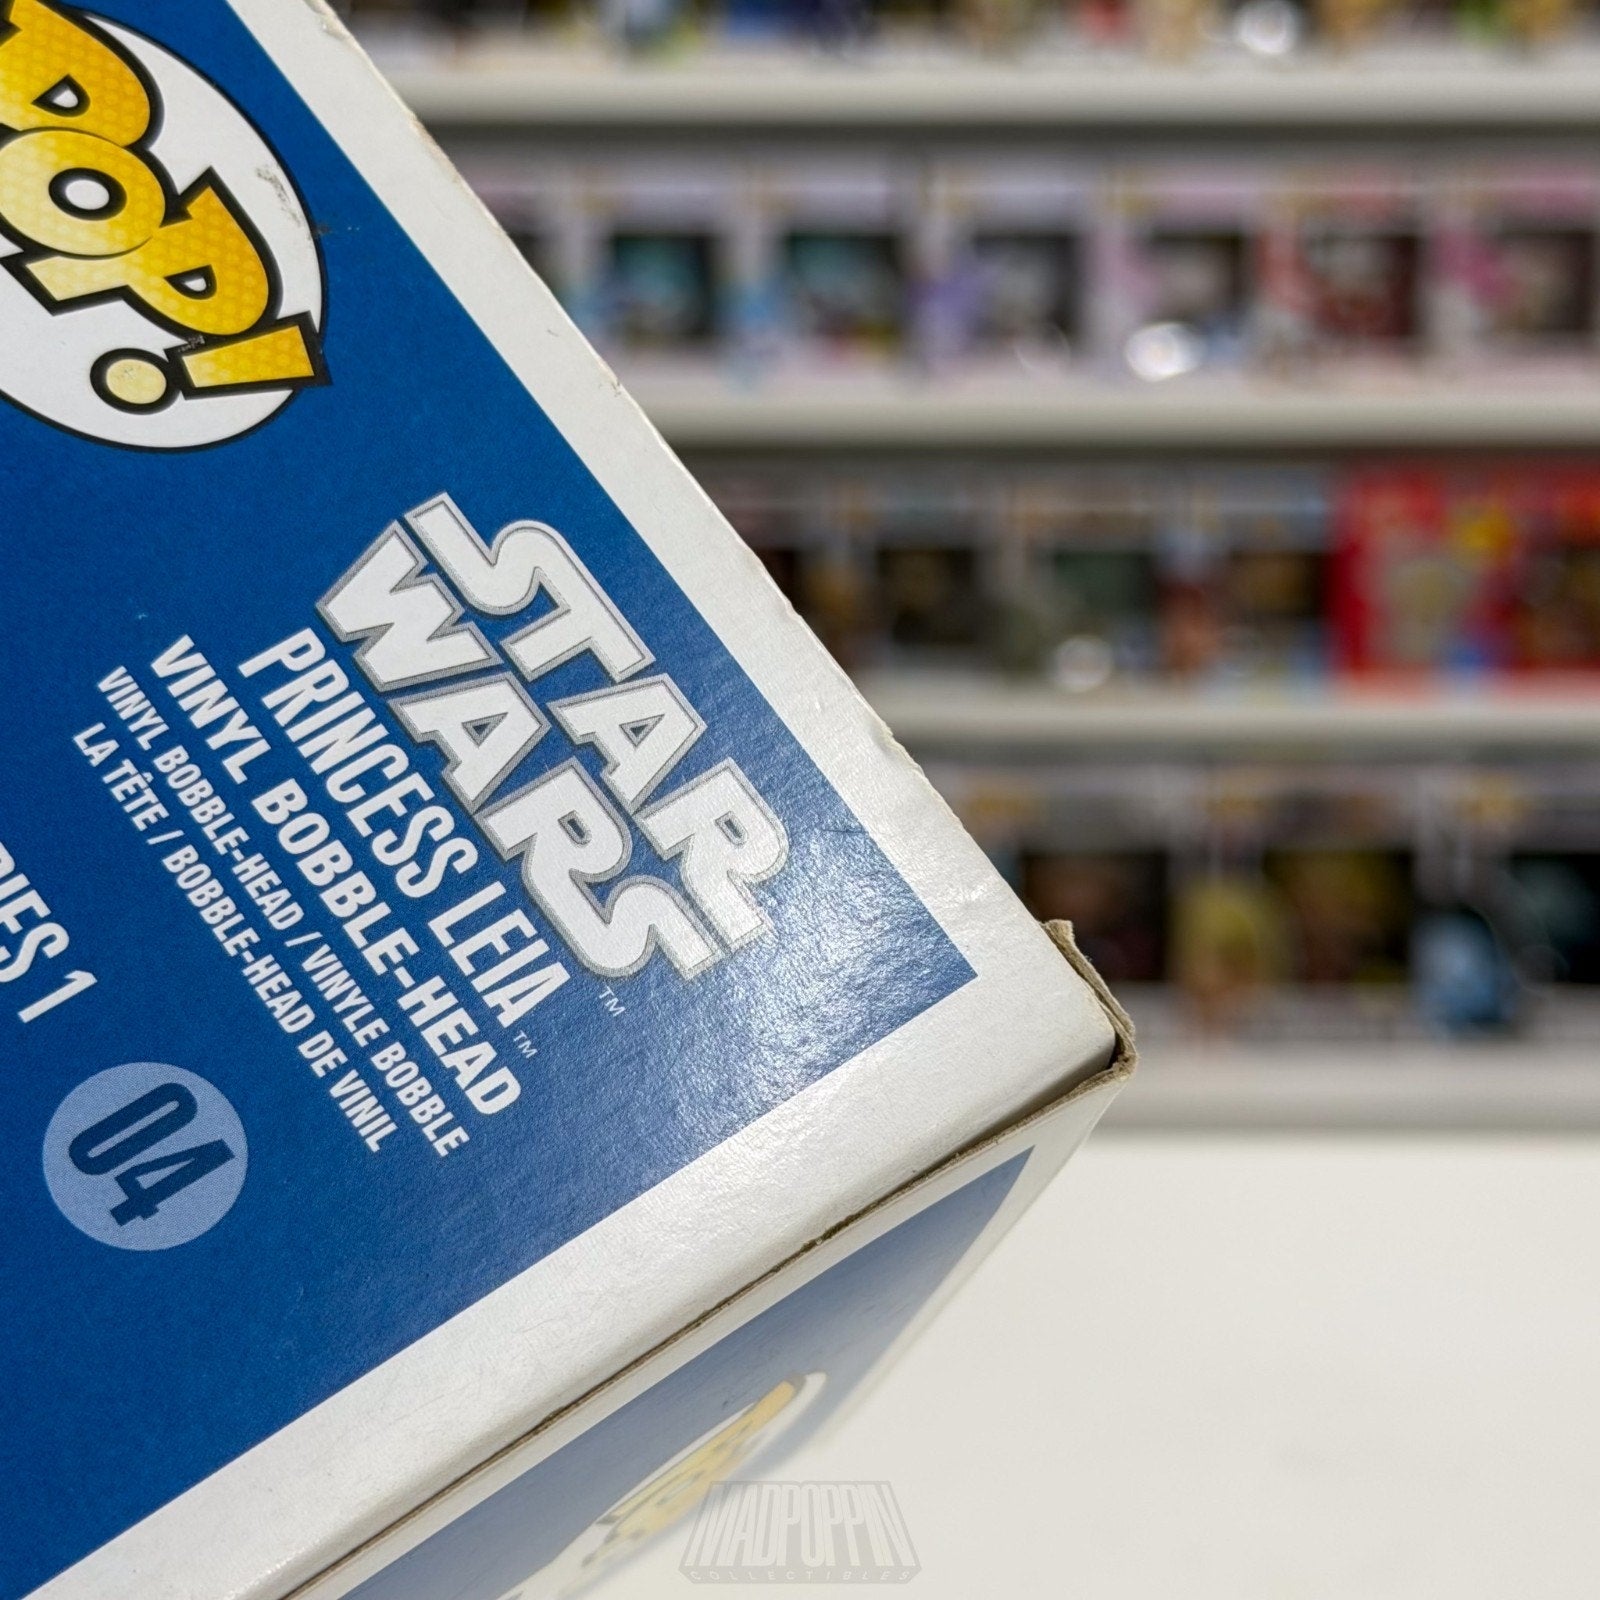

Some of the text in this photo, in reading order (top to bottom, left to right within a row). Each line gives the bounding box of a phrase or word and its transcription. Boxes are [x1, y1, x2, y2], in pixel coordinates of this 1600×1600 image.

[0, 0, 333, 415] POP!
[72, 722, 120, 767] LA
[102, 758, 170, 832] TÊTE
[161, 844, 316, 1034] BOBBLE-HEAD
[297, 1030, 348, 1078] DE
[329, 1069, 398, 1153] VINIL
[97, 665, 170, 751] VINYL
[153, 745, 305, 931] BOBBLE-HEAD
[301, 943, 390, 1048] VINYLE
[370, 1041, 470, 1157] BOBBLE
[150, 635, 521, 1115] VINYL BOBBLE-HEAD
[238, 627, 479, 899] PRINCESS
[428, 881, 571, 1029] LEIA
[315, 520, 724, 981] WARS
[403, 491, 789, 957] STAR
[18, 969, 98, 1023] 1
[68, 1082, 236, 1227] 04
